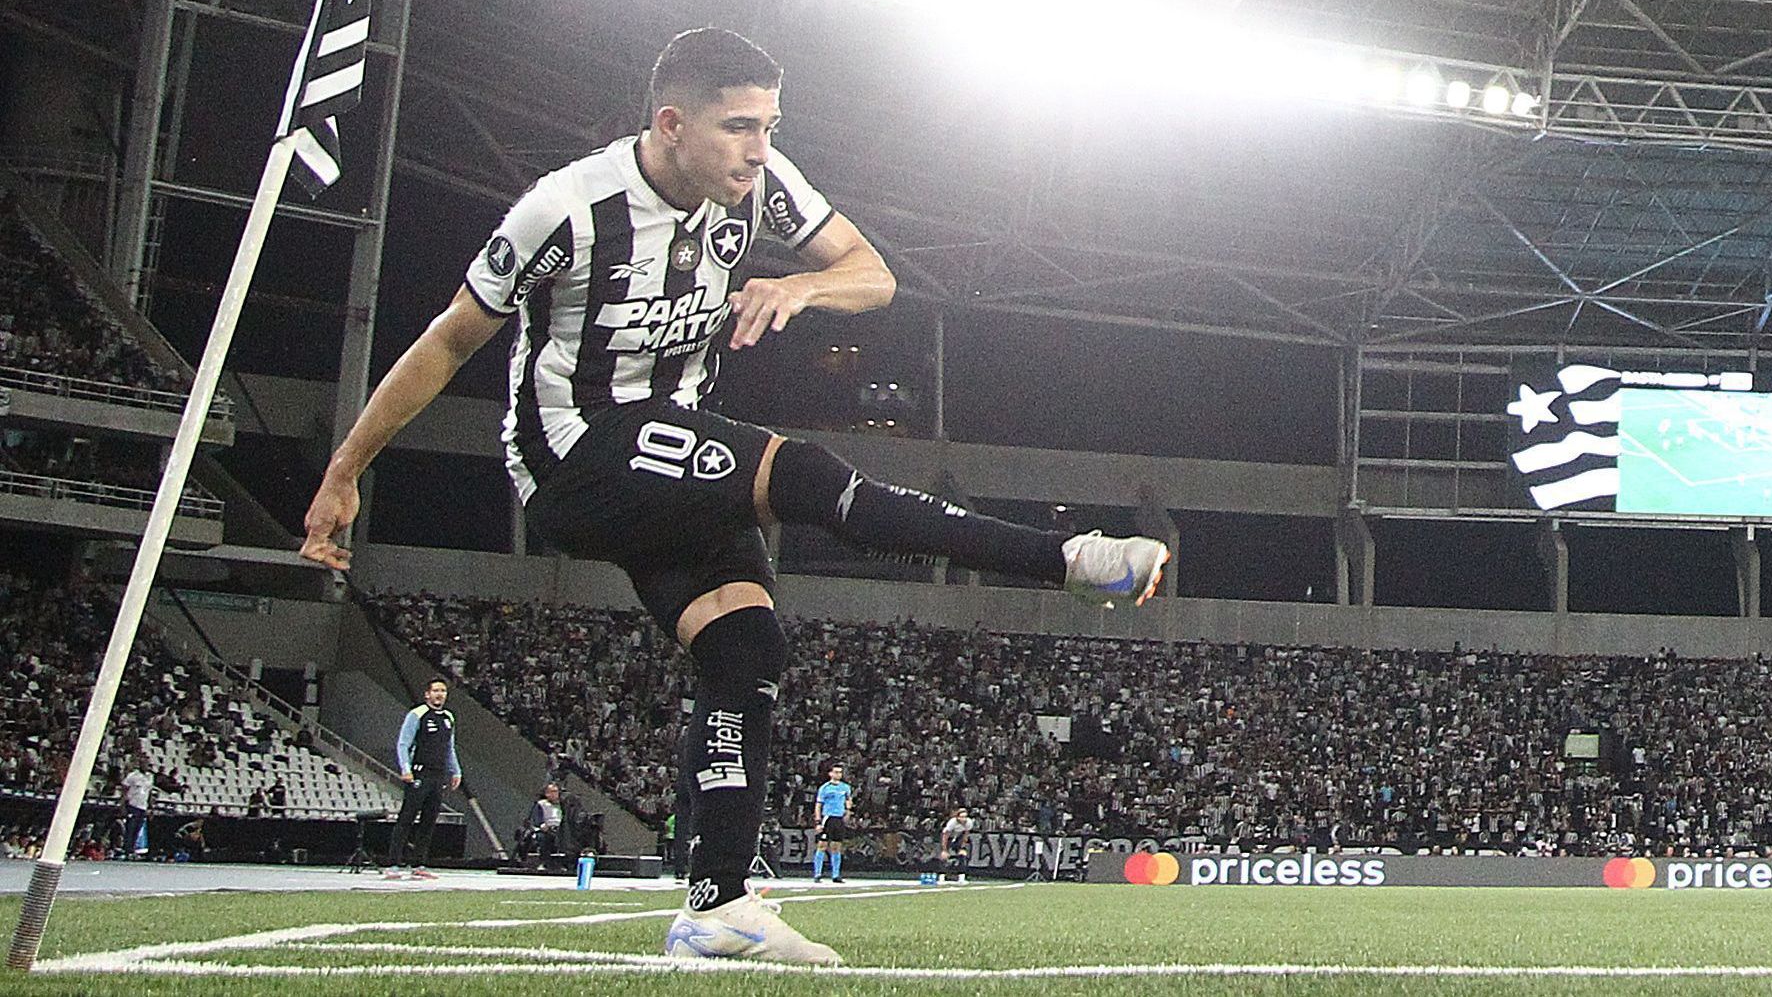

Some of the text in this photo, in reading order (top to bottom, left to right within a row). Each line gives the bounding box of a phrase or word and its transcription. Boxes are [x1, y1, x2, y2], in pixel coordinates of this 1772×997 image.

[595, 288, 705, 328] PARI
[629, 421, 698, 479] 10
[1191, 852, 1386, 886] priceless
